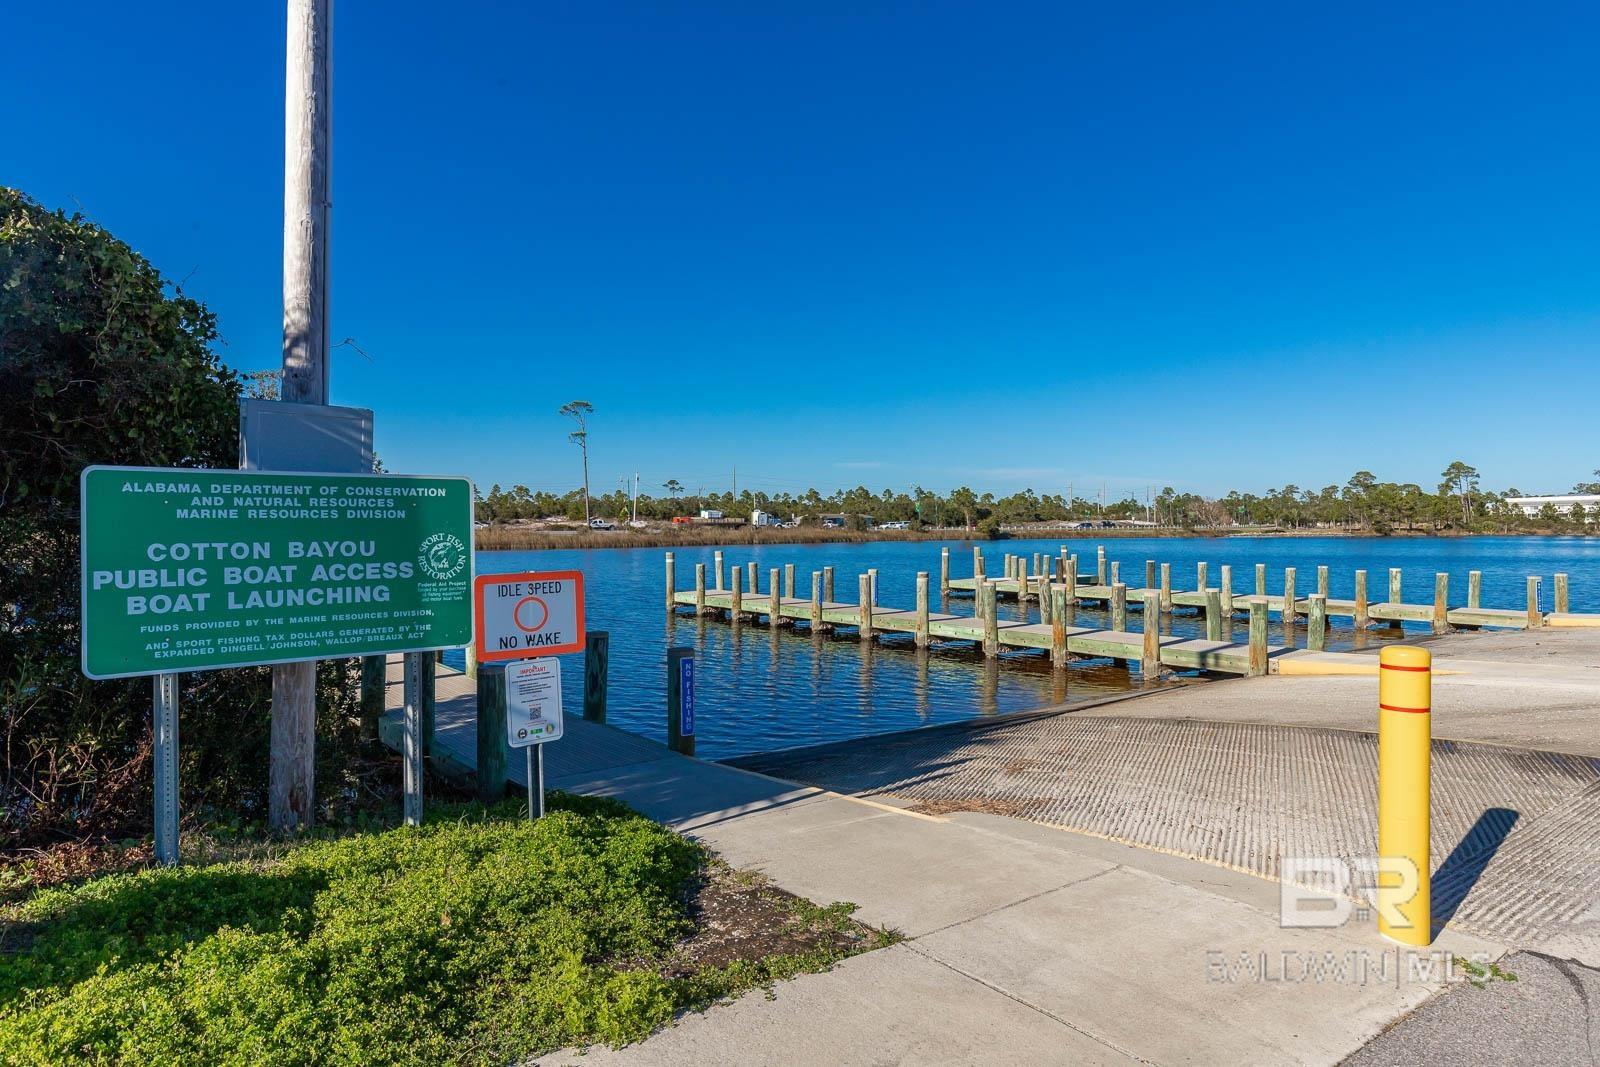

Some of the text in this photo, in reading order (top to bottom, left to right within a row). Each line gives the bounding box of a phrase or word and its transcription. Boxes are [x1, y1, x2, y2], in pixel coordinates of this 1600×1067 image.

[122, 482, 446, 497] ALABAMA DEPARTMENT OF CONSERVATION
[191, 497, 394, 507] AND NATURAL RESOURCES
[176, 510, 406, 519] MARINE RESOURCES DIVISION
[148, 540, 375, 561] COTTON BAYOU
[419, 533, 464, 553] SPORT FISH
[93, 562, 414, 590] PUBLIC BOAT ACCESS
[418, 555, 466, 580] RESTORATION
[498, 582, 562, 597] IDLE SPEED
[128, 585, 390, 615] BOAT LAUNCHING
[140, 624, 179, 633] FUNDS
[186, 621, 240, 630] PROVIDED
[246, 619, 259, 627] BY
[290, 616, 326, 624] MARINE
[332, 612, 388, 621] RESOURCES
[393, 610, 434, 618] DIVISION,
[145, 642, 169, 650] AND
[176, 639, 212, 648] SPORT
[218, 635, 260, 645] FISHING
[291, 630, 334, 639] DOLLARS
[340, 627, 393, 635] GENERATED
[154, 648, 214, 658] EXPANDED
[221, 644, 264, 653] DINGELL
[270, 640, 320, 649] JOHNSON,
[326, 636, 362, 645] WALLOP
[367, 633, 402, 642] BREAUX
[500, 632, 561, 649] NO WAKE
[685, 664, 691, 676] NO
